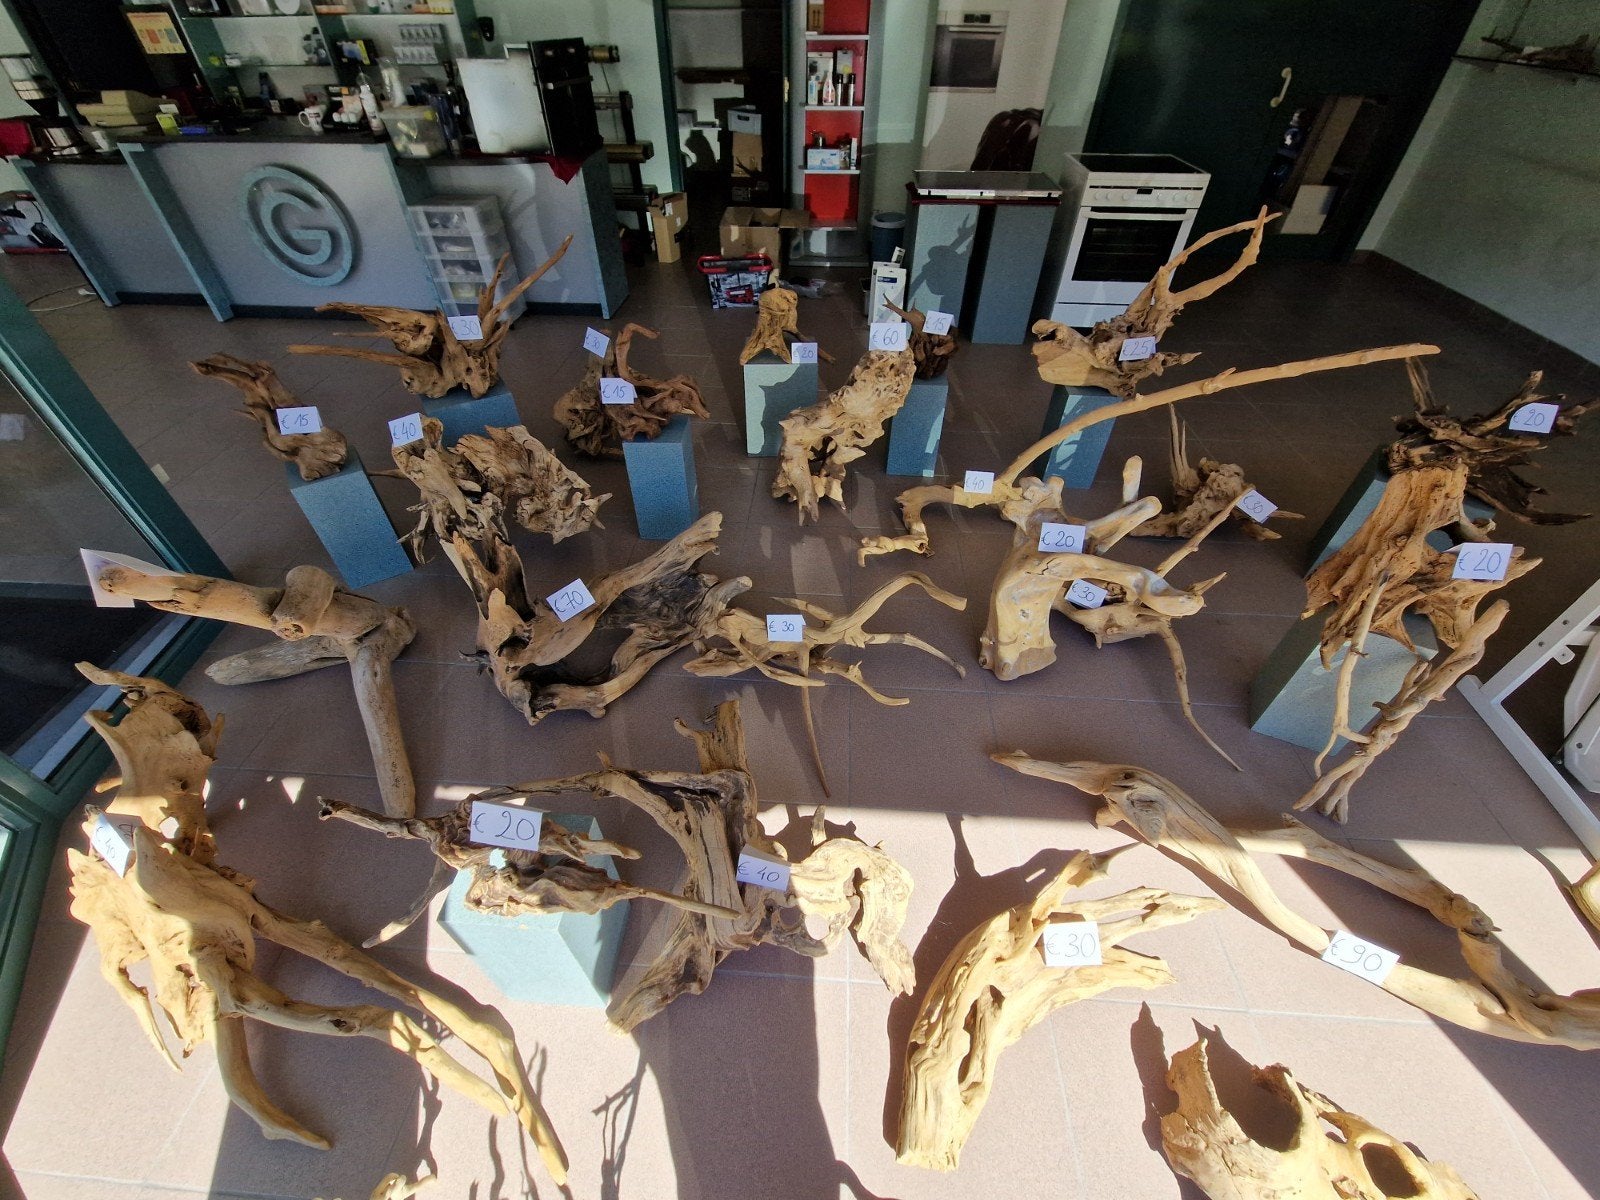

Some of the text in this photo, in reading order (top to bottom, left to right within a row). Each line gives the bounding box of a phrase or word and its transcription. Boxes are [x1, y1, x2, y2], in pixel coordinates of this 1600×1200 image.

[1523, 408, 1545, 427] 20
[1055, 530, 1075, 547] 20
[1473, 548, 1501, 574] 20
[781, 620, 795, 632] 30
[494, 810, 536, 841] 20
[1065, 932, 1097, 958] 30
[1340, 944, 1383, 972] 90
